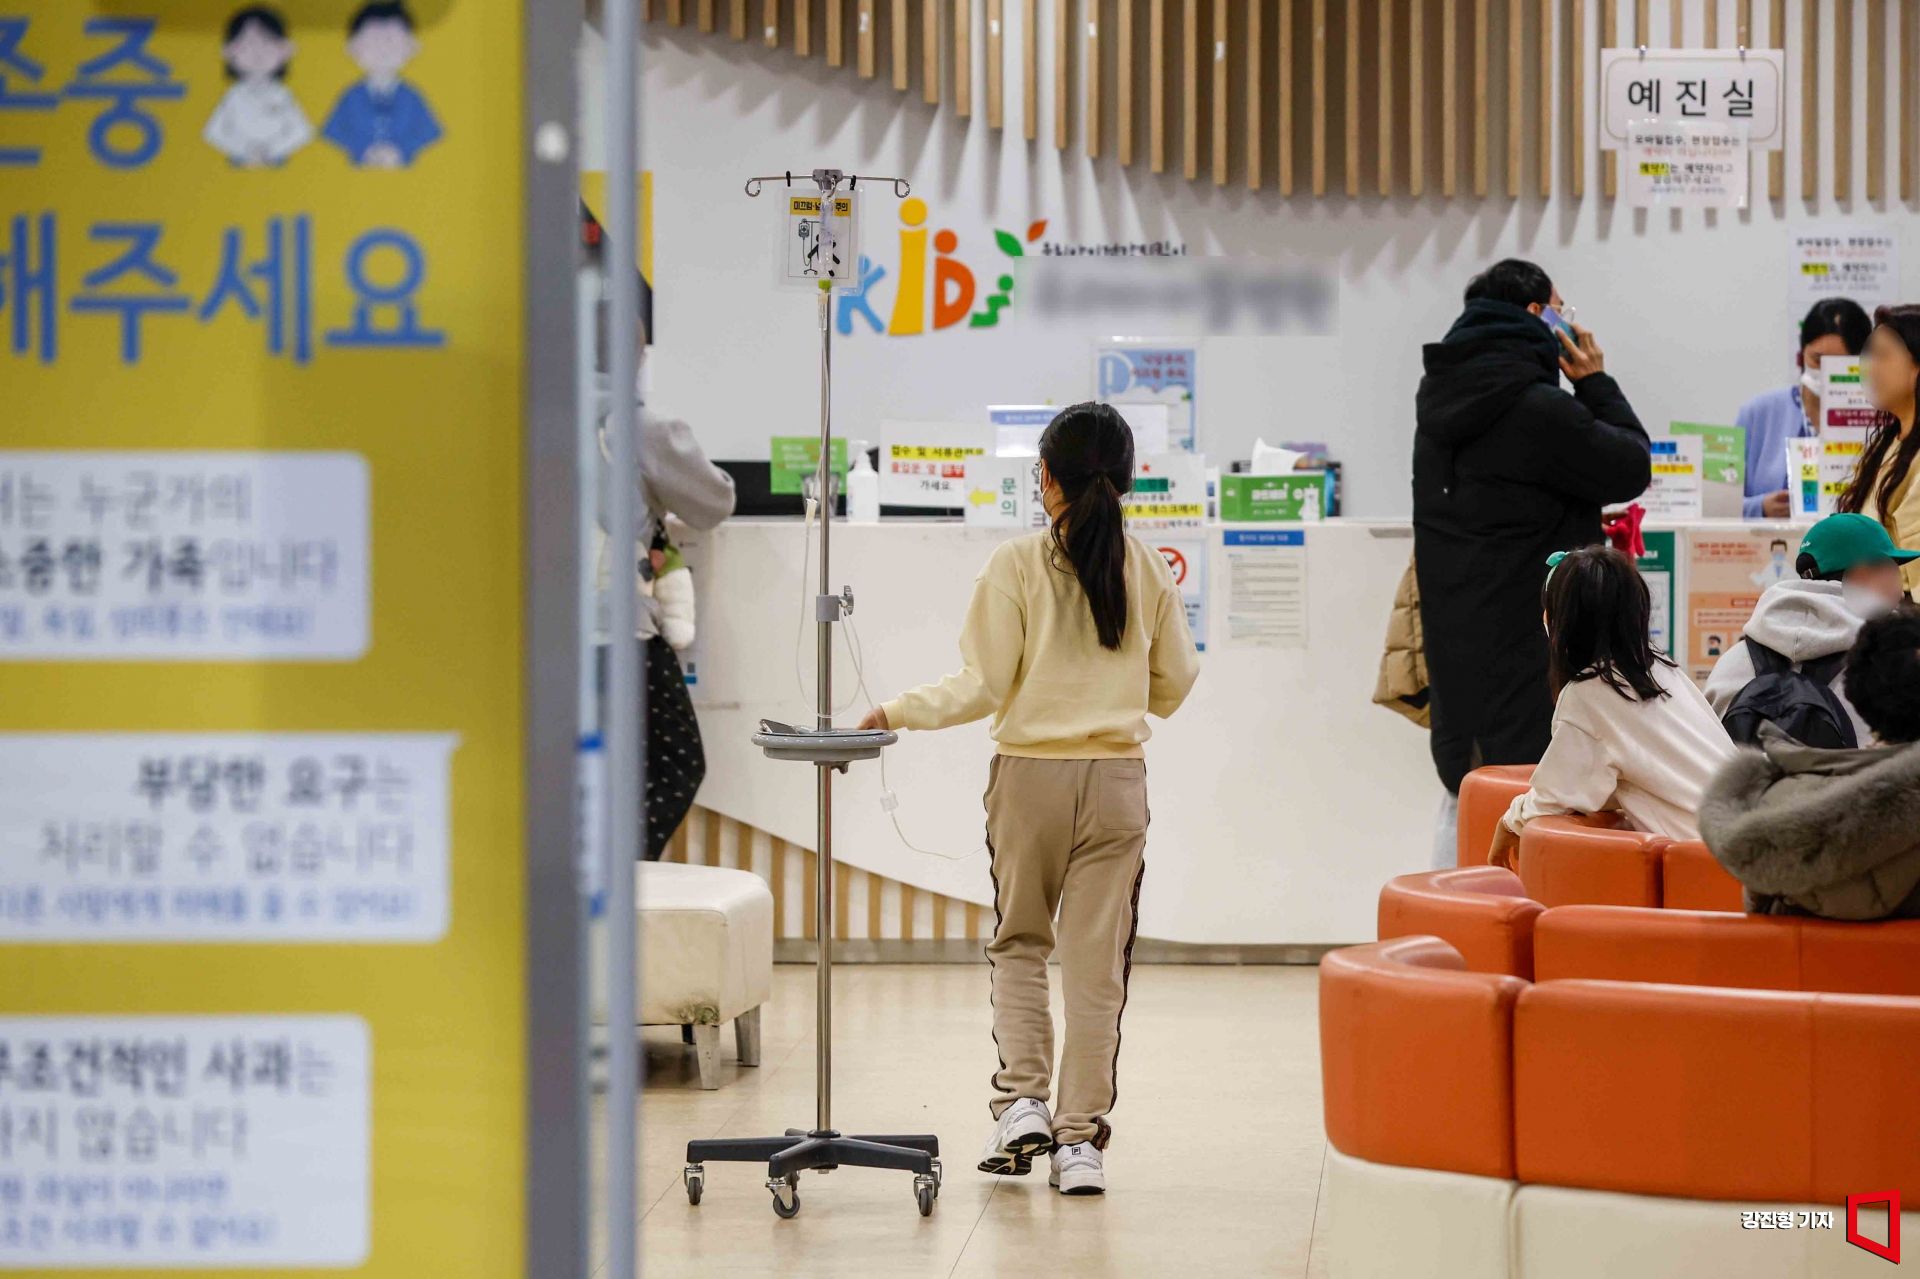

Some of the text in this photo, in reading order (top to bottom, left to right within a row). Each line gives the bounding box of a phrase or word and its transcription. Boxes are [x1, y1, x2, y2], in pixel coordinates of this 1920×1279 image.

[836, 202, 848, 212] 주의
[75, 472, 252, 530] 누군가의
[1001, 477, 1017, 518] 문의
[121, 537, 339, 597] 가족입니다
[136, 754, 412, 813] 부당한 요구는
[39, 819, 415, 877] 처리할 수 없습니다
[203, 1036, 336, 1098] 사과는
[73, 1104, 249, 1164] 않습니다
